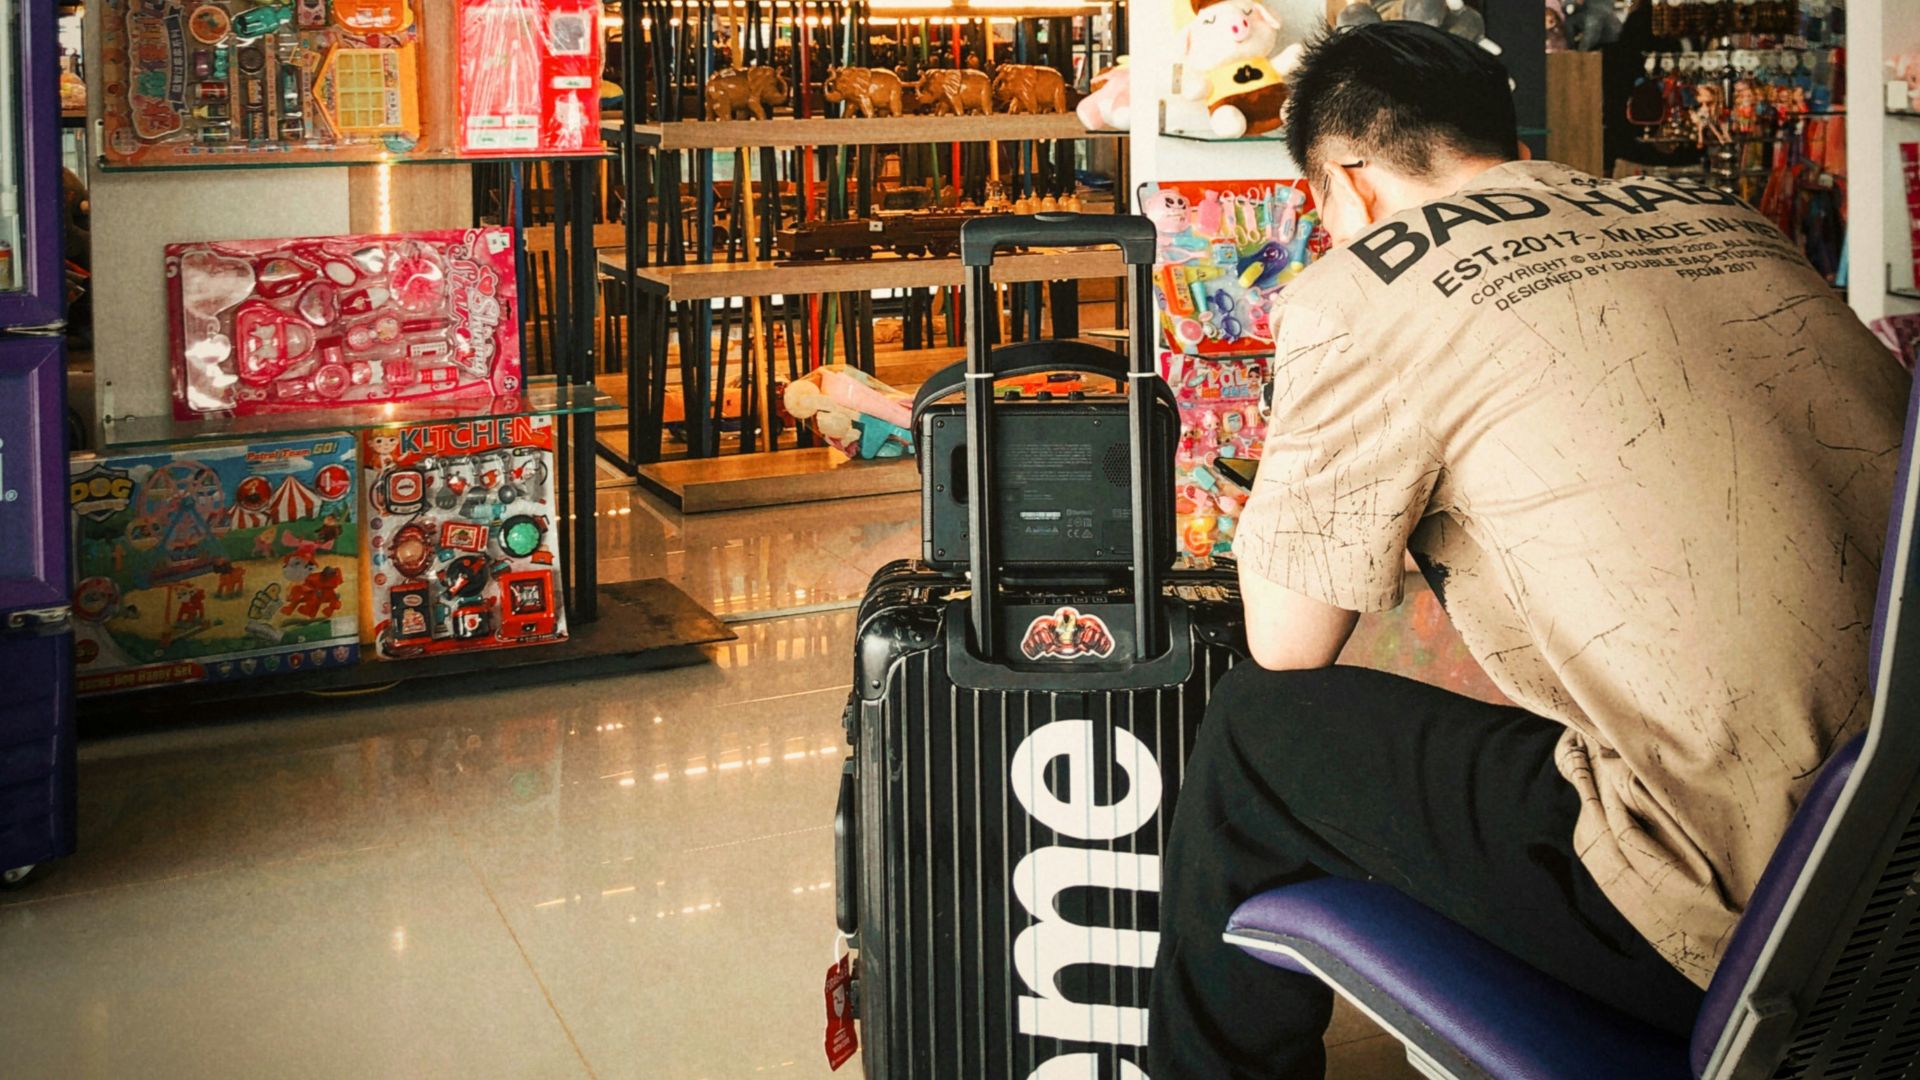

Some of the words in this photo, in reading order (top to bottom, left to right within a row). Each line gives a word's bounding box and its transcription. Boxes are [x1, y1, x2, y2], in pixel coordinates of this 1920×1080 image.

[1347, 192, 1551, 285] BAD
[1600, 221, 1701, 243] MADE
[1699, 217, 1732, 233] IN
[1471, 257, 1567, 306] COPYRIGHT
[1587, 249, 1623, 263] BAD
[1627, 245, 1683, 257] HABITS
[1495, 269, 1584, 312] DESIGNED
[1584, 263, 1610, 277] BY
[1611, 257, 1680, 271] DOUBLE
[1679, 254, 1713, 266] BAD
[1676, 265, 1723, 279] FROM
[1727, 262, 1758, 274] 2017
[313, 441, 338, 455] GO!
[400, 414, 533, 455] KITCHEN
[71, 477, 134, 500] DOG
